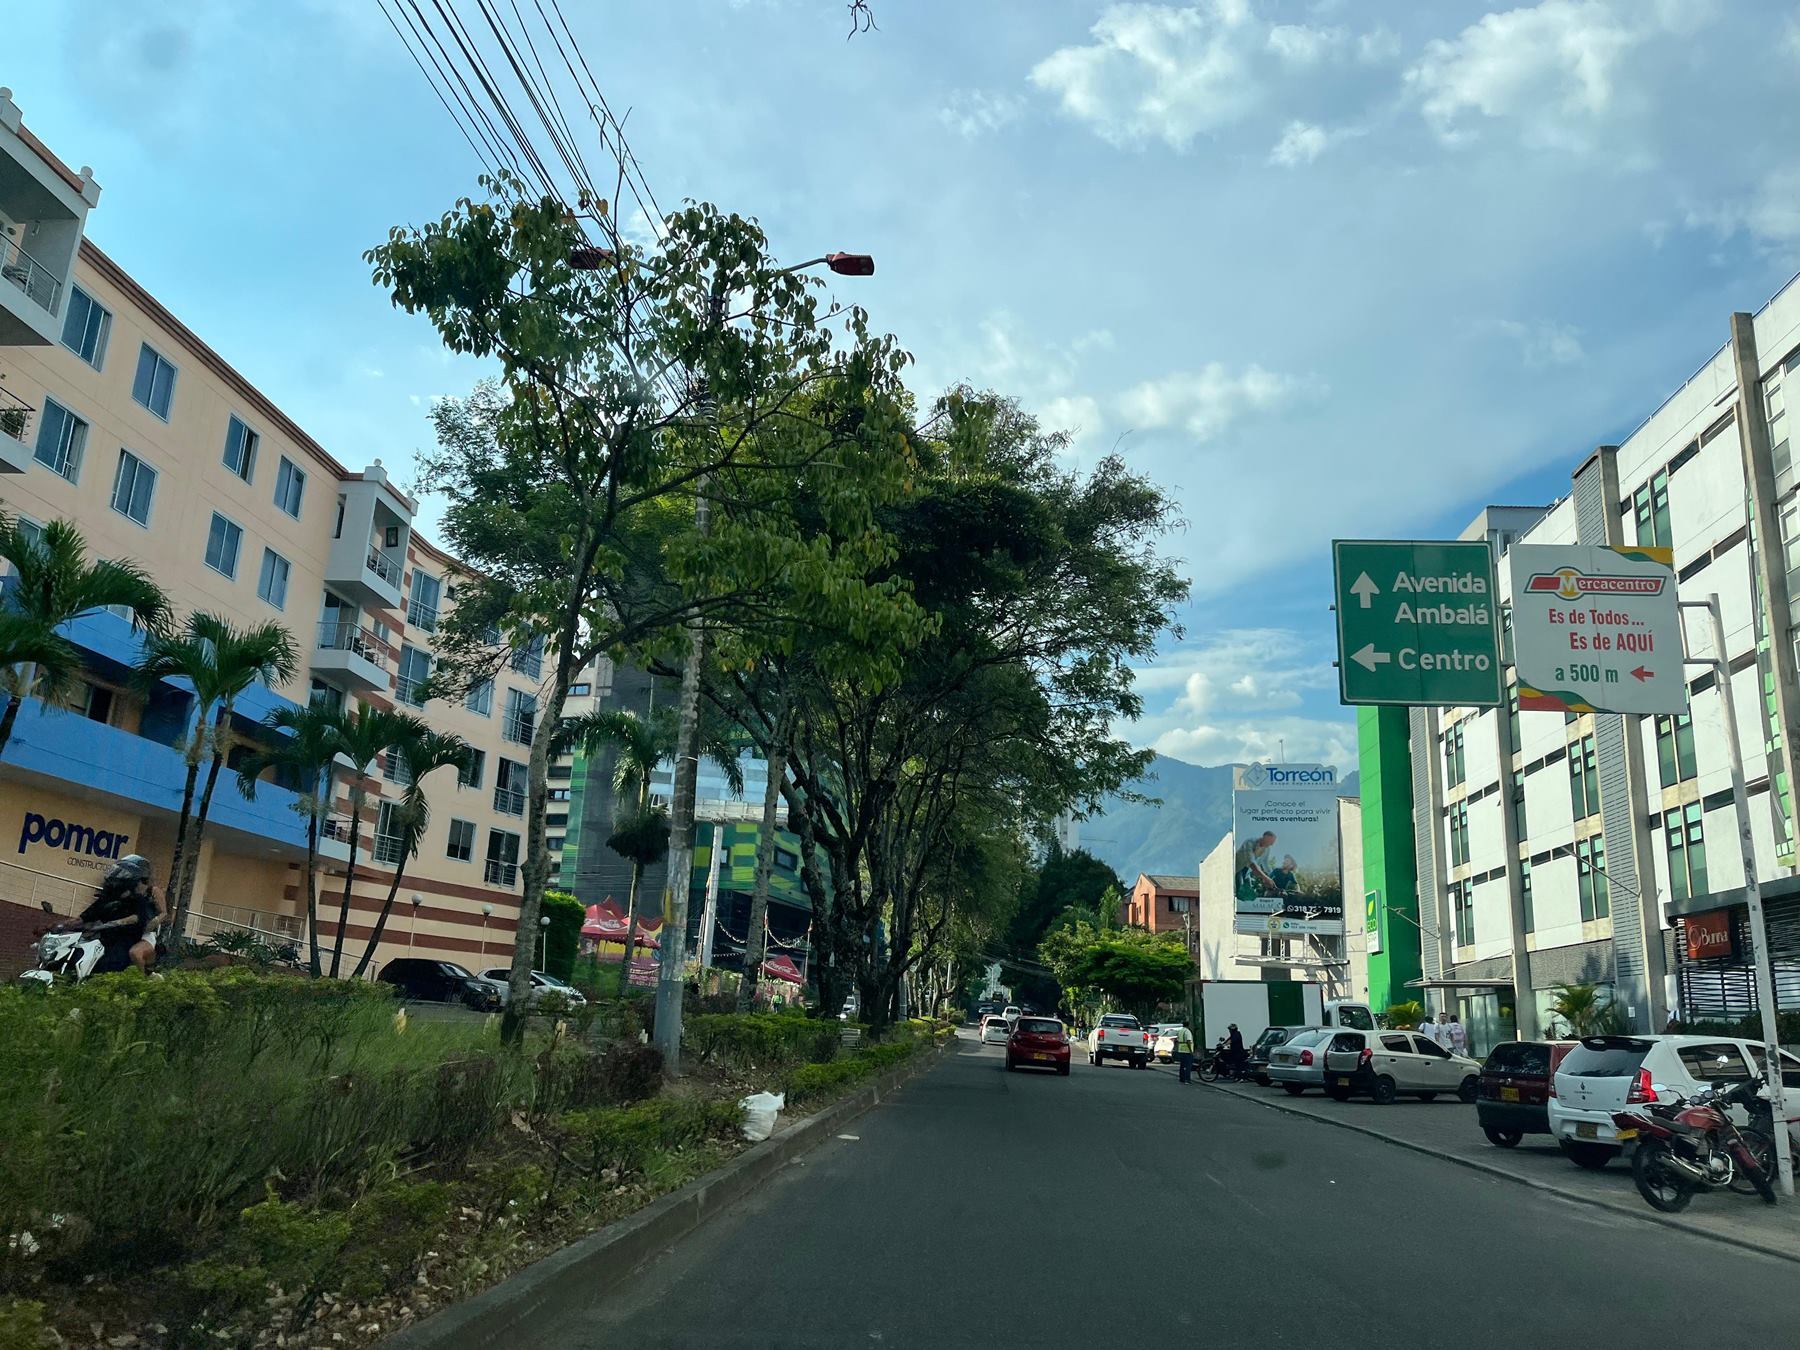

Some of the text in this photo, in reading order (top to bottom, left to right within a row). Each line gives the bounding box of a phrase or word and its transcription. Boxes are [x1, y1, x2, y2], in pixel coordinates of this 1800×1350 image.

[1392, 571, 1486, 593] Avenida
[1559, 575, 1656, 591] Mercacentro
[1394, 602, 1489, 625] Ambalá
[1549, 608, 1564, 624] Es
[1569, 609, 1585, 625] de
[1569, 630, 1654, 652] Es de AQUÍ
[1398, 648, 1490, 671] Centro
[1555, 664, 1619, 683] a 500 m
[1265, 767, 1333, 782] Torreón
[1240, 807, 1259, 815] lugar
[1261, 807, 1294, 815] perfecto
[18, 811, 129, 860] pomar
